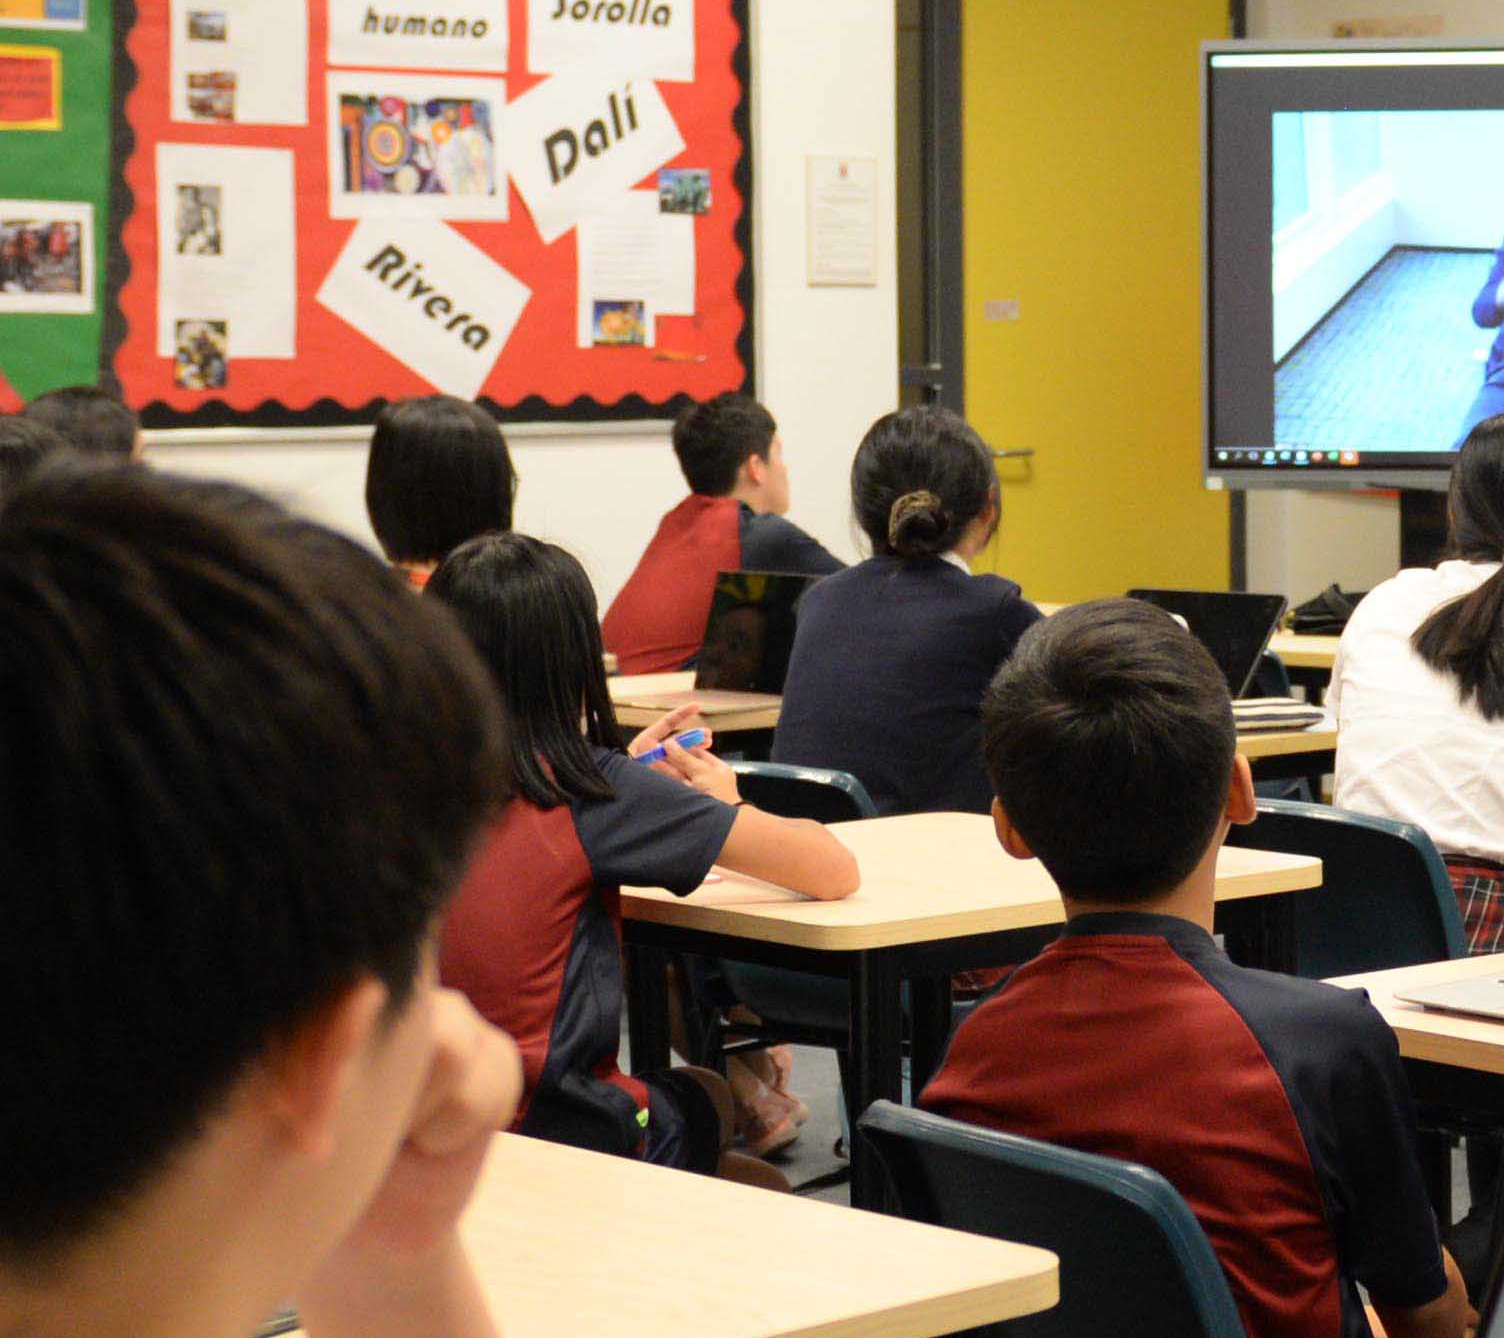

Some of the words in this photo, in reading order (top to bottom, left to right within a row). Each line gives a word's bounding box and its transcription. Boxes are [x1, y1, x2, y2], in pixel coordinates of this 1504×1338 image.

[362, 6, 489, 38] humano
[543, 82, 640, 185] Dalí
[363, 244, 491, 352] Rivera
